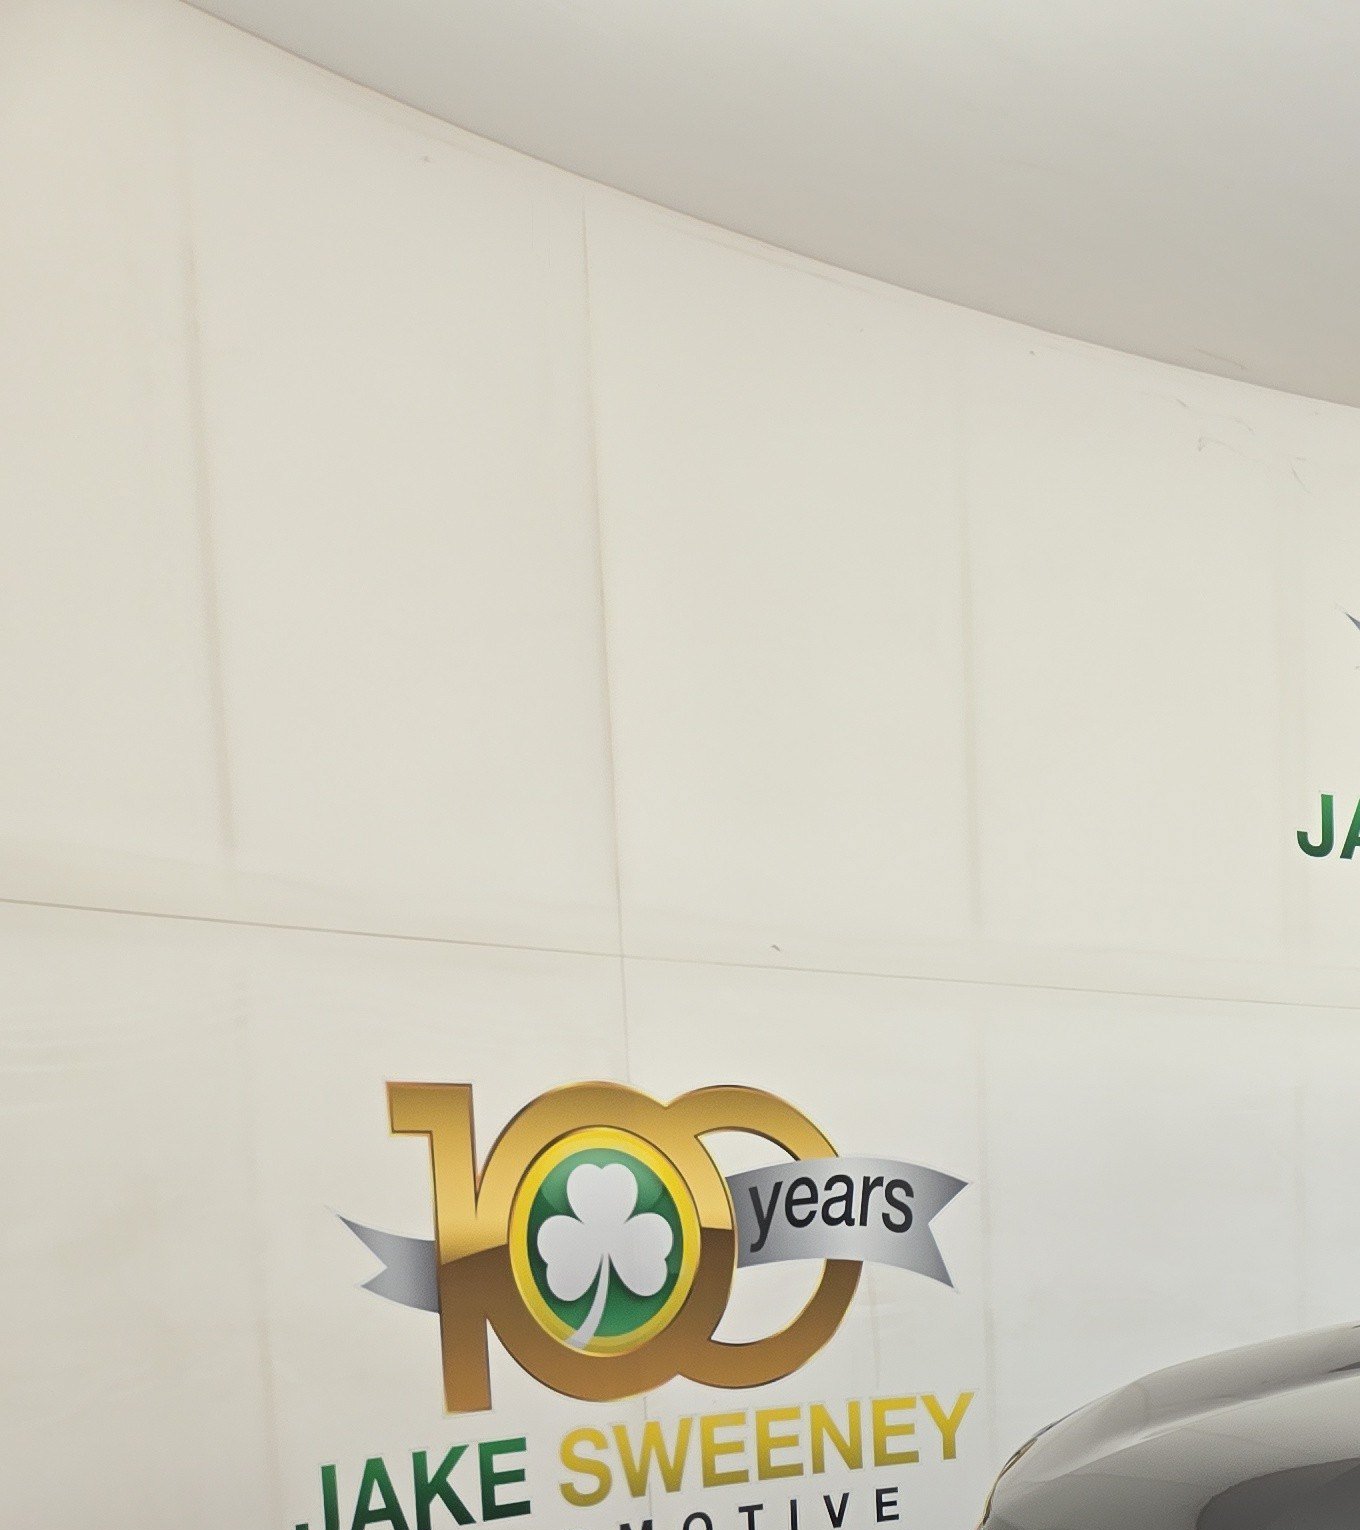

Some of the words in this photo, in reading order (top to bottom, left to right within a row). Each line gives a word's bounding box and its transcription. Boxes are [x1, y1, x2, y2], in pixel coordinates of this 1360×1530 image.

[387, 1081, 863, 1414] 100
[748, 1173, 915, 1253] years
[559, 1392, 975, 1508] SWEENEY
